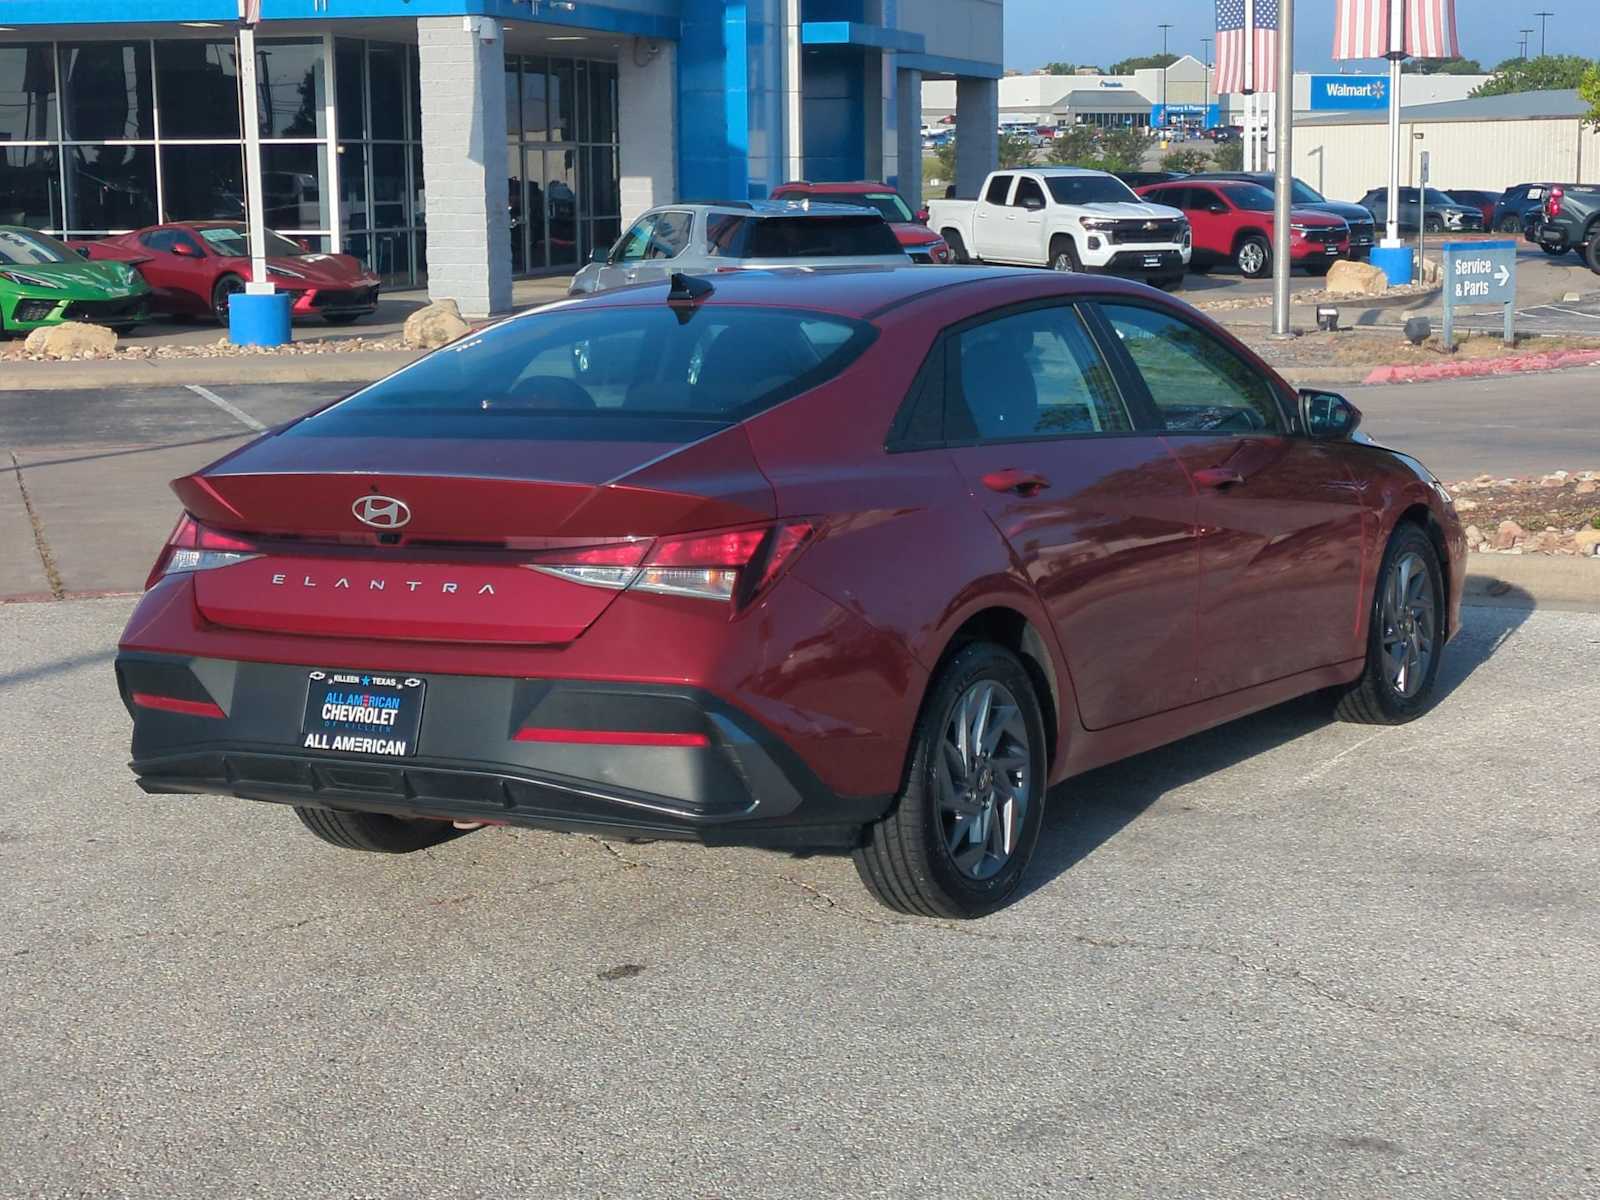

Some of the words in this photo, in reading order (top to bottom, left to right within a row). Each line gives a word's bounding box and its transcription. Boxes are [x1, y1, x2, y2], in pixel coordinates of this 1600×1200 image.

[1326, 83, 1372, 96] Walmart
[1455, 258, 1492, 275] Service
[1455, 283, 1462, 296] &
[1464, 281, 1489, 296] Parts
[271, 574, 495, 595] ELANTRA
[333, 674, 360, 684] KILLEEN
[371, 677, 397, 687] TEXAS
[325, 692, 345, 705] ALL
[346, 694, 400, 709] AMERICAN
[321, 703, 398, 726] CHEVROLET
[304, 733, 330, 749] ALL
[331, 735, 406, 756] AMERICAN
